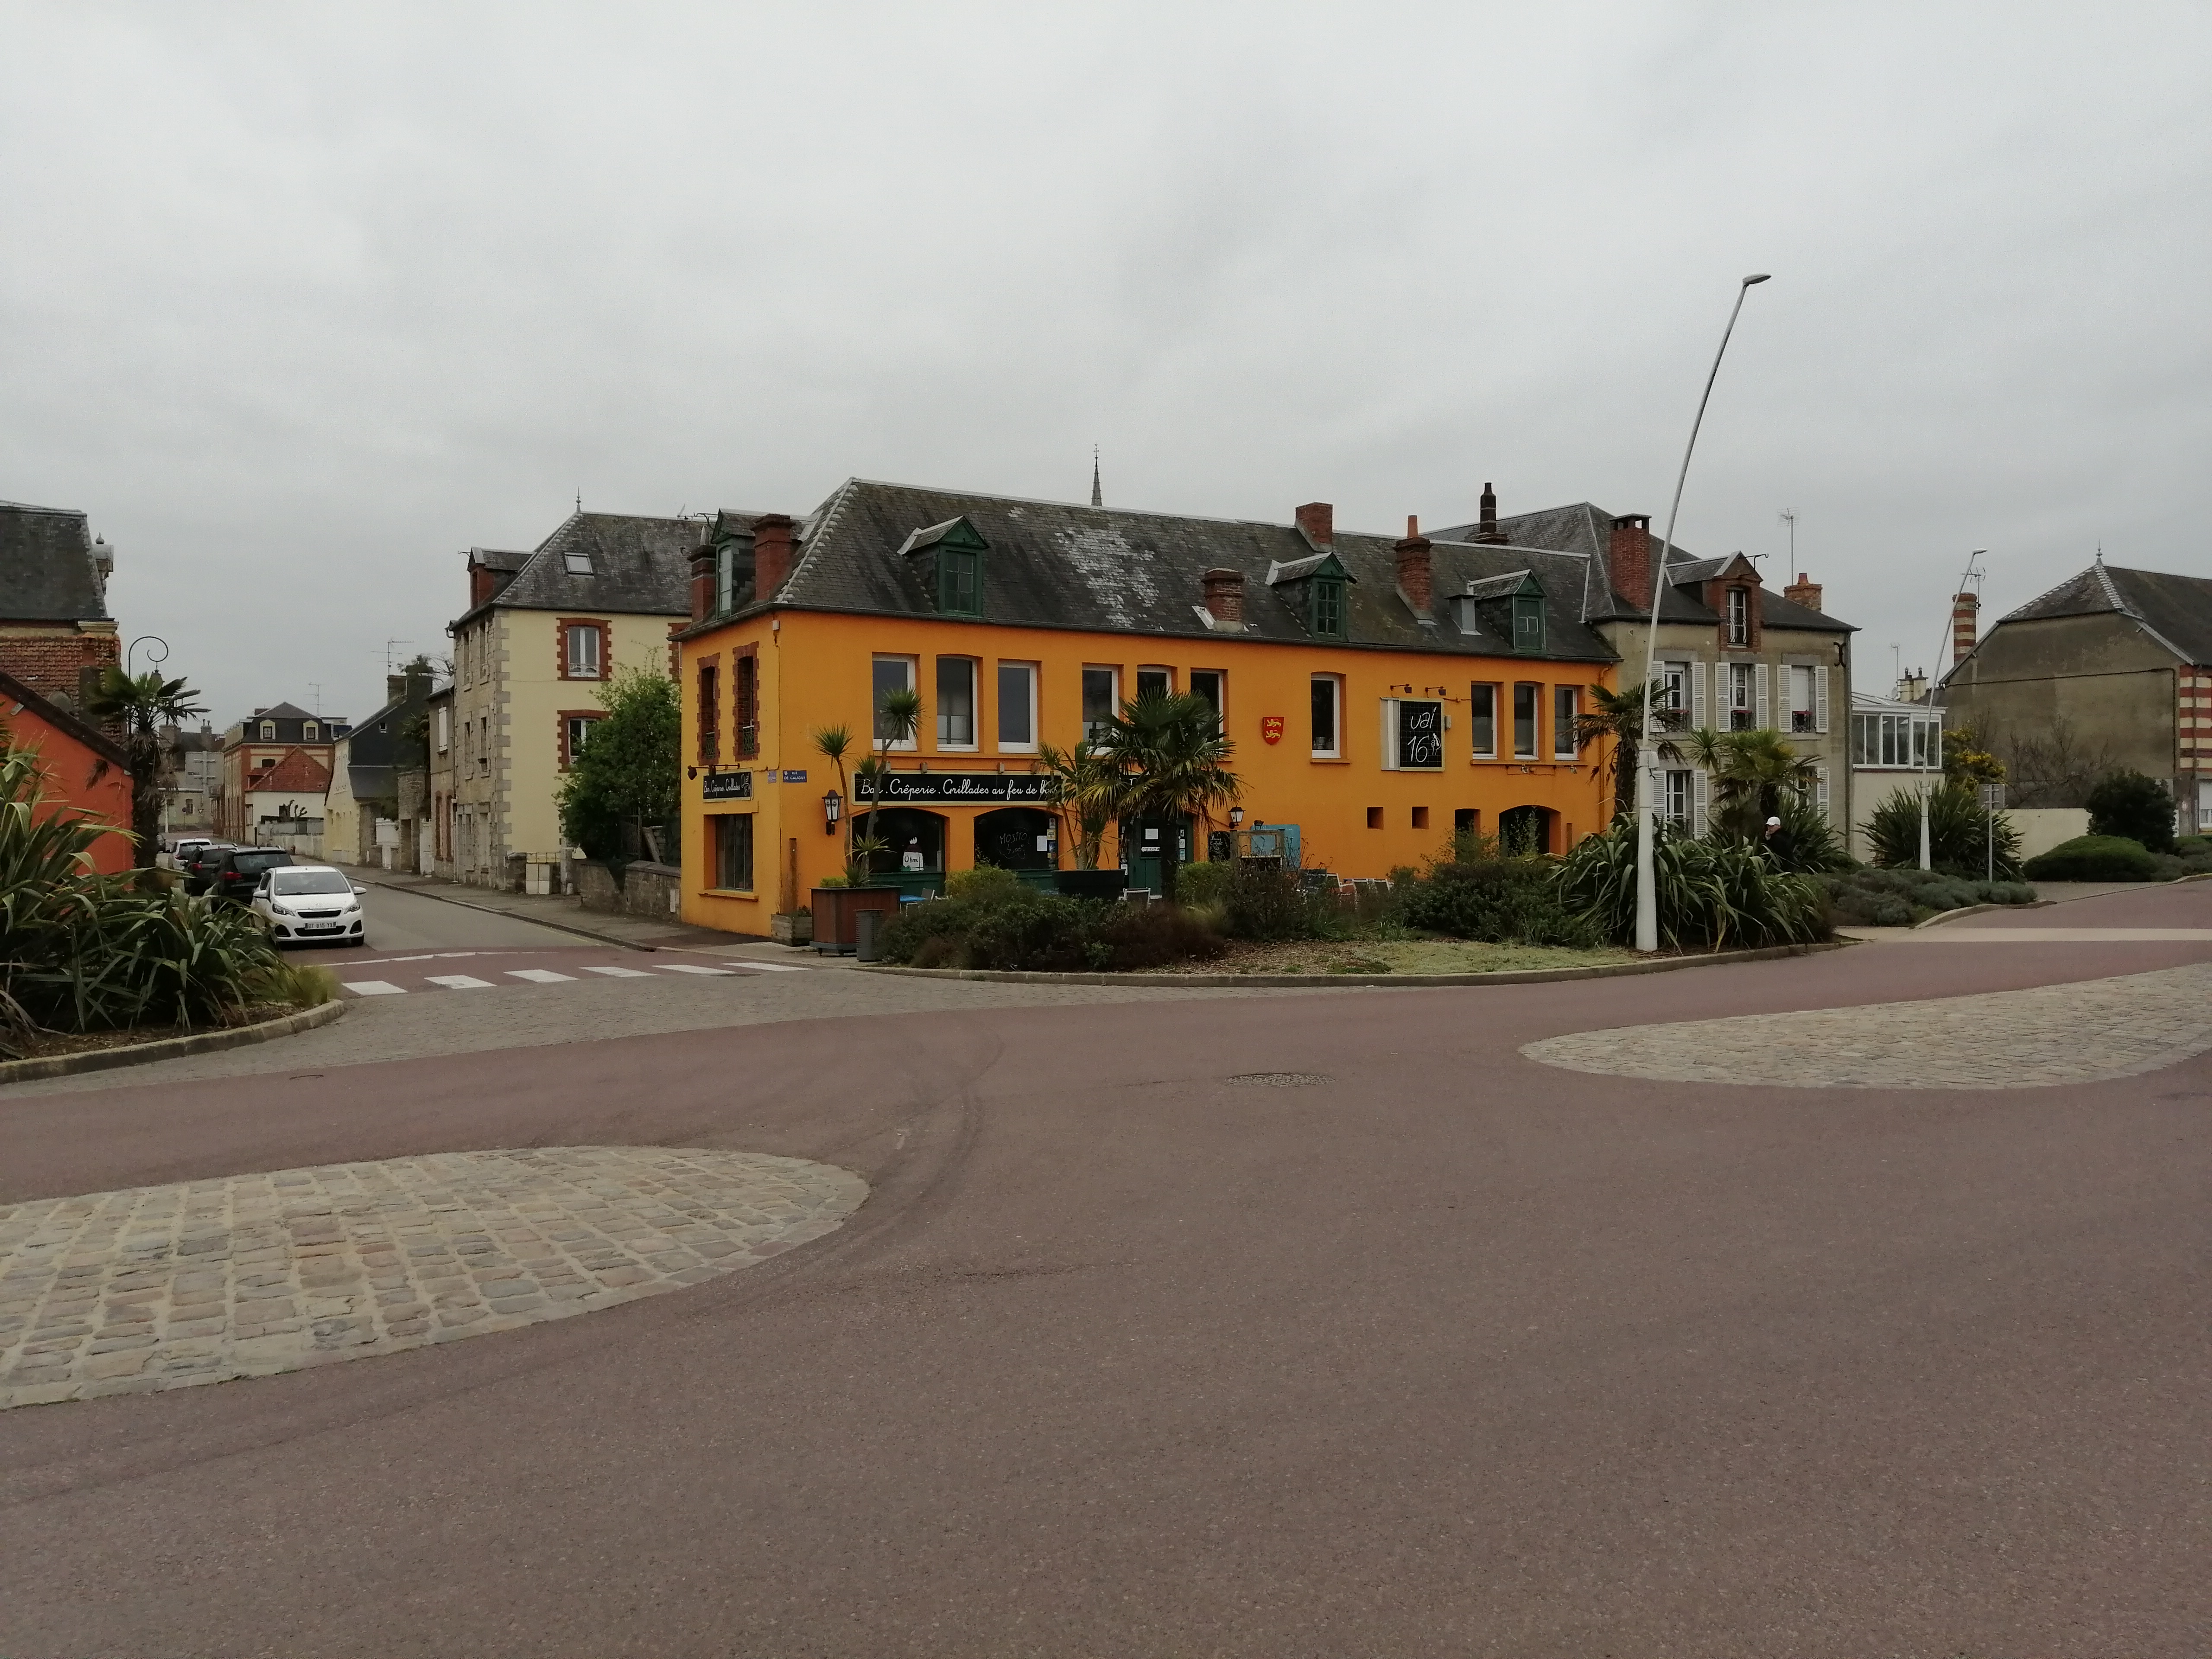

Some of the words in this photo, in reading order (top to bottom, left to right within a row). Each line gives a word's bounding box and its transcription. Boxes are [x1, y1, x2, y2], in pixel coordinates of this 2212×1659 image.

[1407, 735, 1430, 763] 16
[890, 778, 937, 801] Crêperie
[943, 779, 989, 795] Grillades
[1006, 779, 1024, 801] feu
[1026, 784, 1038, 795] de
